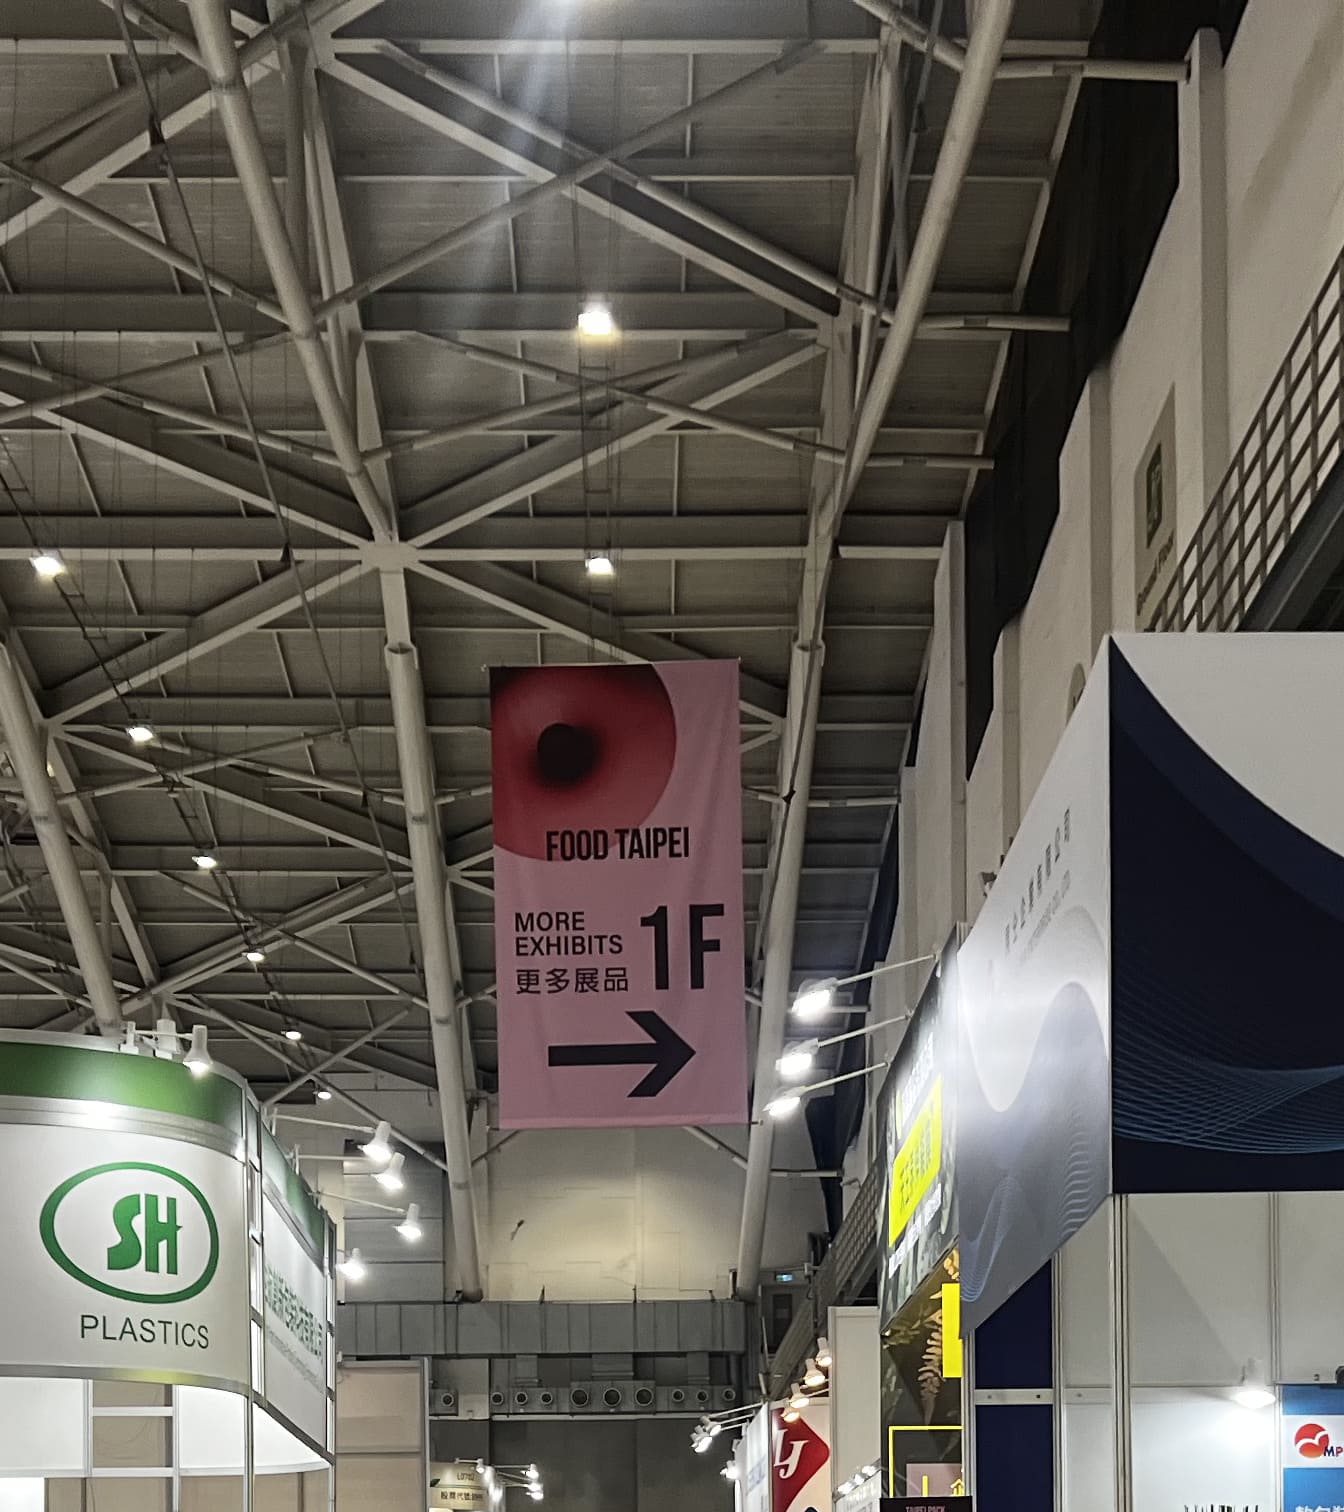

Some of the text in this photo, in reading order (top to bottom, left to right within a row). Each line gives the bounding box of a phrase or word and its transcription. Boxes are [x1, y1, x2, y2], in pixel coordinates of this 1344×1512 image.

[546, 827, 690, 862] FOOD TAIPEI
[515, 935, 623, 957] EXHIBITS
[515, 903, 725, 990] MORE 1F
[515, 967, 629, 995] 更多展品
[107, 1193, 182, 1275] SH
[81, 1314, 209, 1349] PLASTICS
